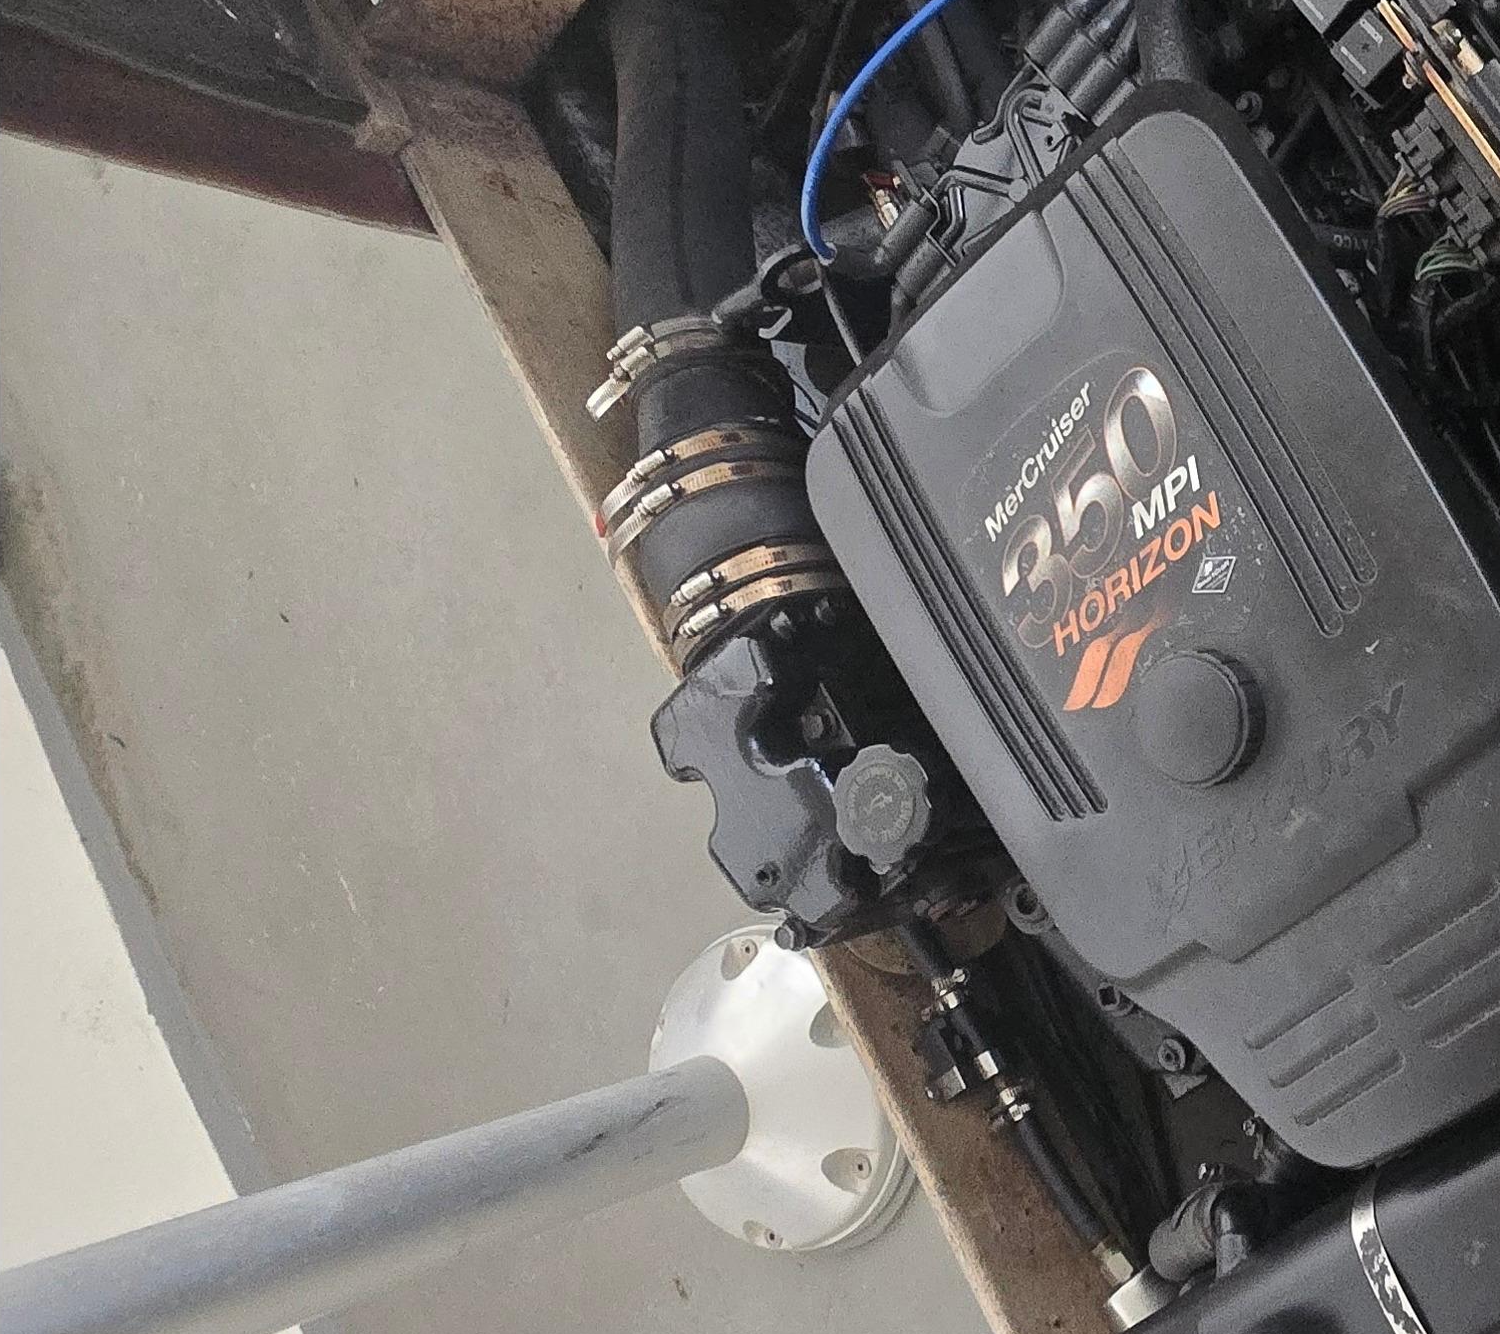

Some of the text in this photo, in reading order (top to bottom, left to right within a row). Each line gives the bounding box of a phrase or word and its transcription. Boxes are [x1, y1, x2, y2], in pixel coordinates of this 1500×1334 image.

[984, 382, 1093, 542] MerCruiser
[1002, 366, 1201, 648] 350 MPI
[1052, 492, 1221, 656] HORIZON
